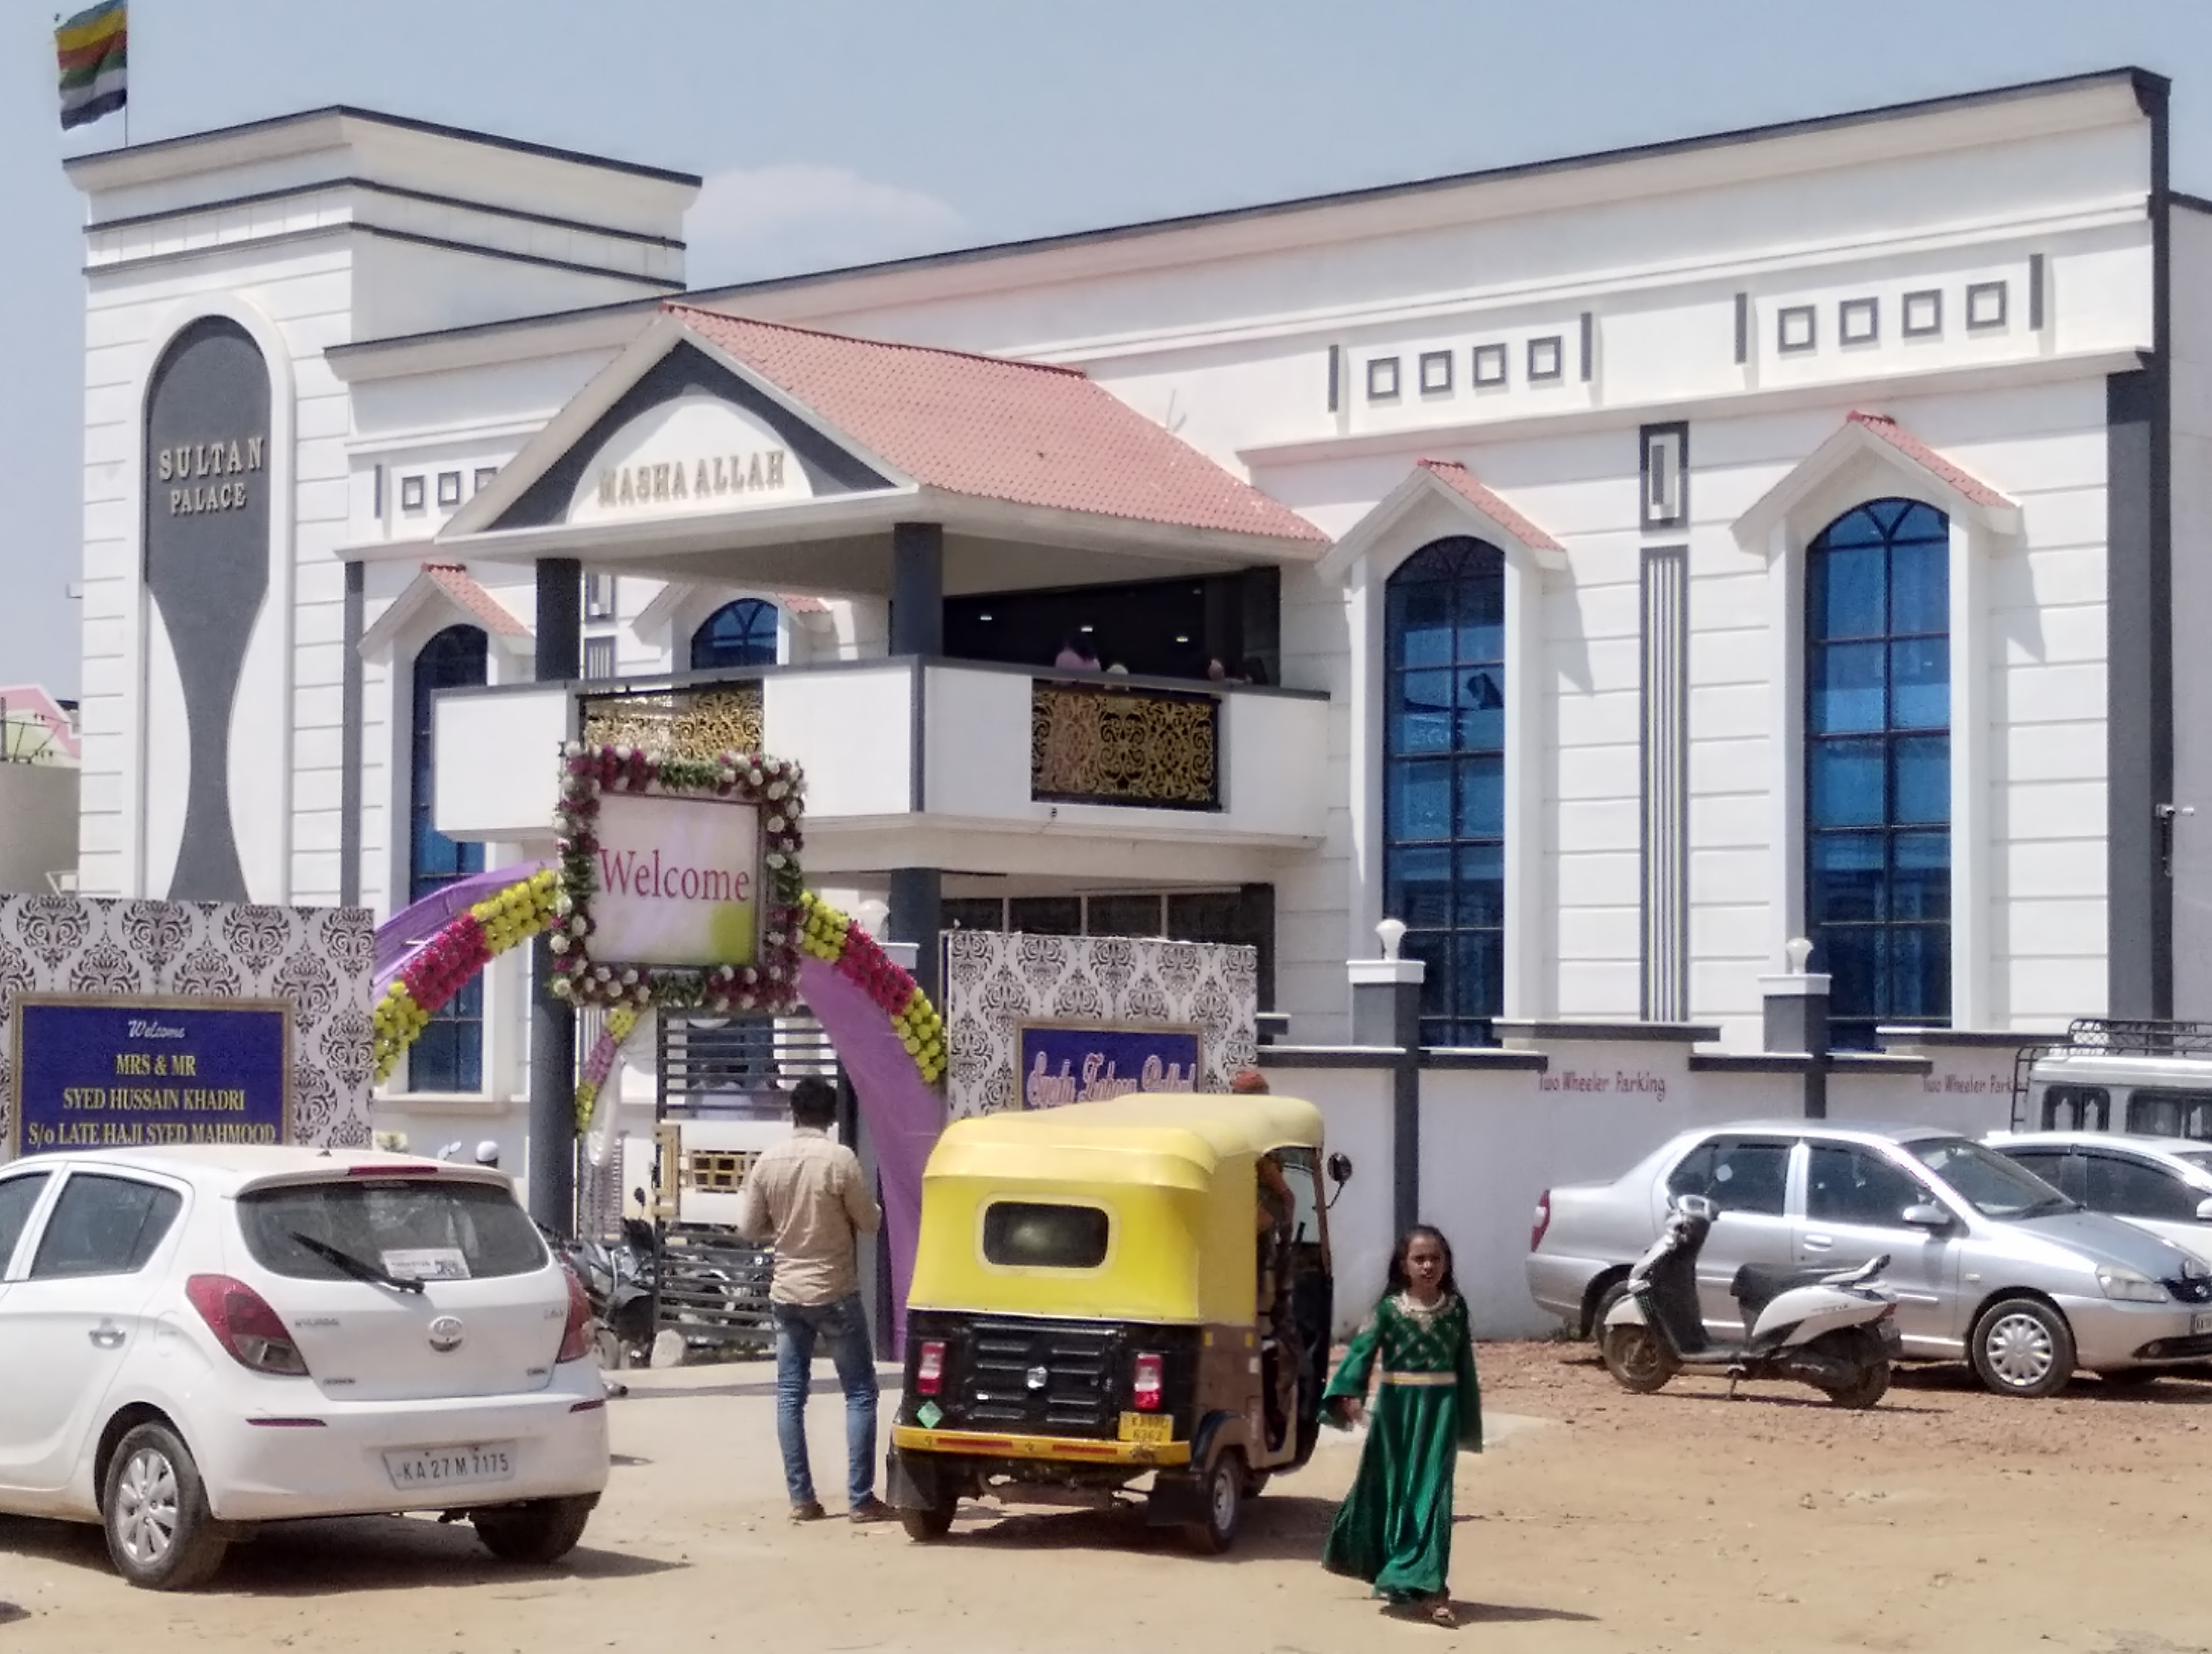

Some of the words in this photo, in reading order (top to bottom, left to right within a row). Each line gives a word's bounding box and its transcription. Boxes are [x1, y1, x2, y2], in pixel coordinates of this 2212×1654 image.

[159, 435, 264, 482] SULTAN
[694, 450, 785, 498] ALLAH
[172, 483, 247, 516] PALACE
[600, 849, 749, 901] Welcome
[128, 1020, 185, 1038] Welcome
[116, 1054, 150, 1075] MRS
[154, 1055, 166, 1076] &
[172, 1056, 196, 1076] MR
[63, 1088, 106, 1109] SYED
[109, 1088, 179, 1110] HUSSAIN
[184, 1089, 245, 1110] KHADRI
[1615, 1071, 1666, 1102] Parking
[59, 1123, 100, 1144] LATE
[104, 1124, 143, 1144] HAJI
[146, 1124, 187, 1144] SYED
[192, 1124, 275, 1144] MAHMOOD
[403, 1461, 426, 1480] KA
[431, 1458, 450, 1478] 27
[454, 1457, 468, 1476] M
[473, 1452, 509, 1473] 7175
